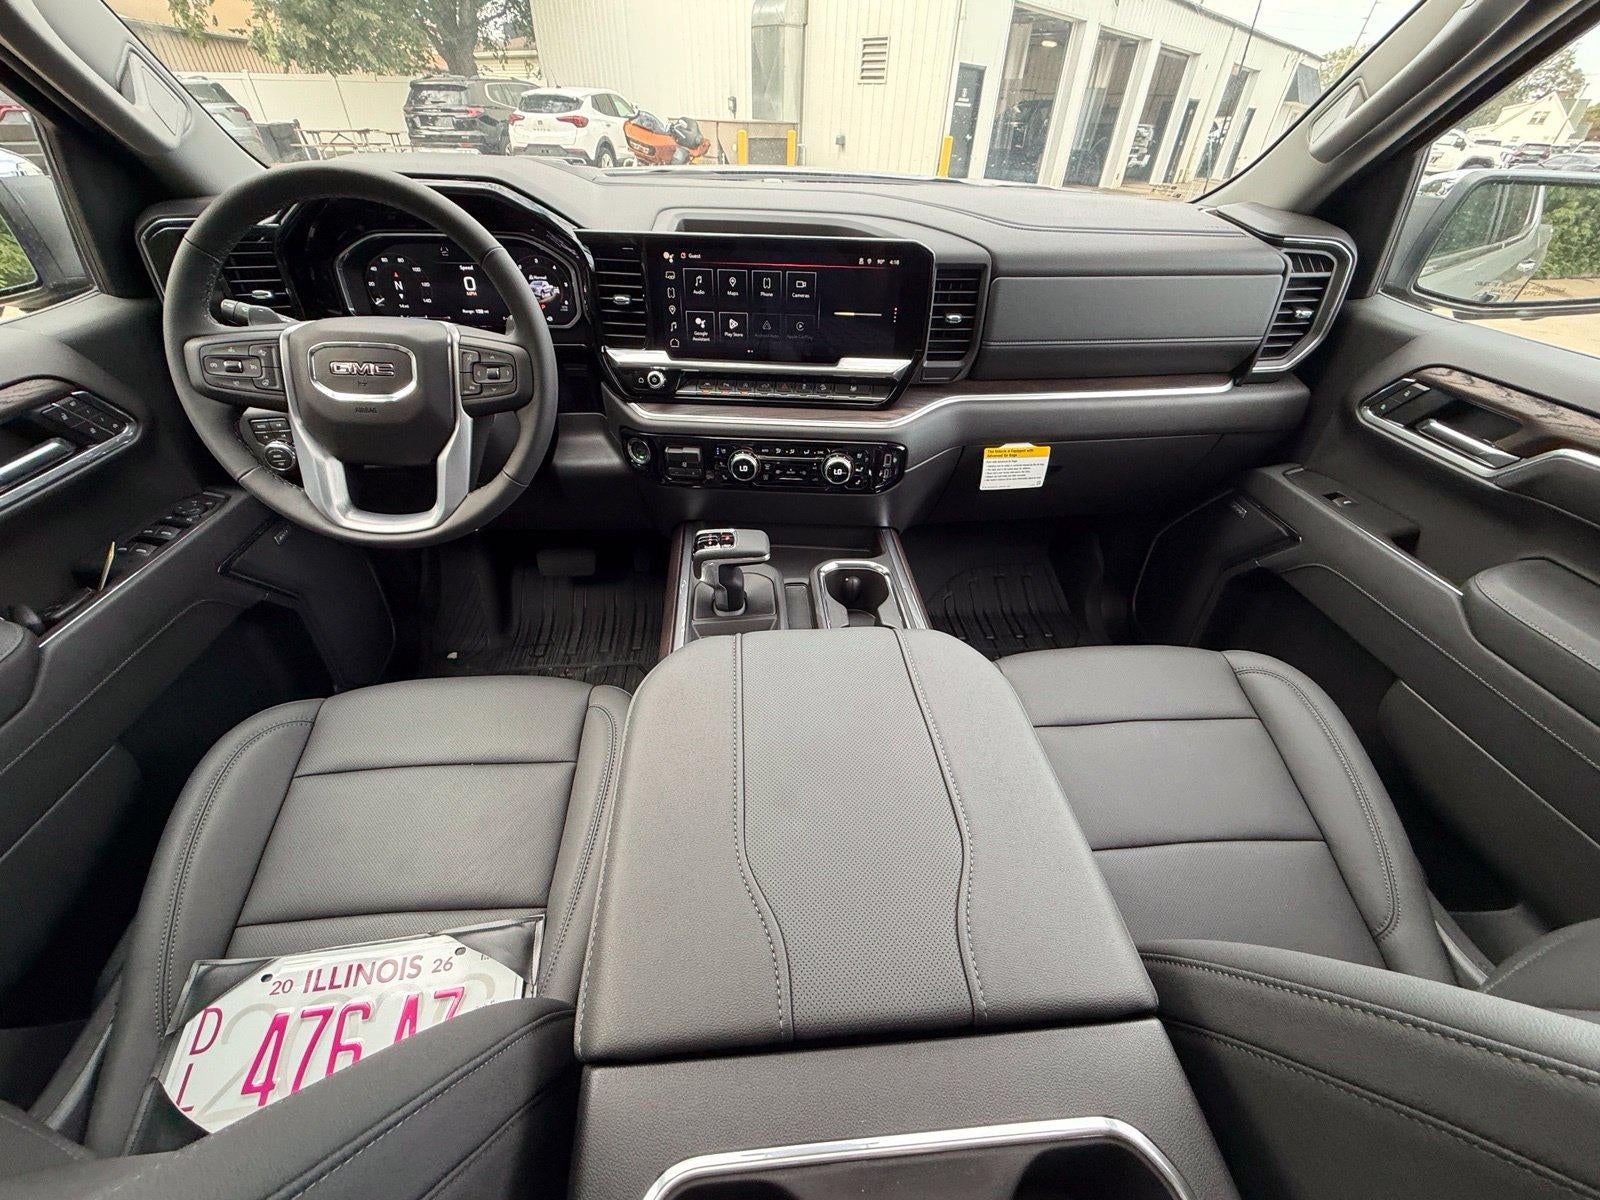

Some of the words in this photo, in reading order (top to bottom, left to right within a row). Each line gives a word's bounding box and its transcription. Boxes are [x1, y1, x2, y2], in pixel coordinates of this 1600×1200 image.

[394, 280, 403, 290] N
[463, 276, 477, 291] 0
[329, 361, 394, 376] GMC
[269, 979, 294, 996] 20
[303, 954, 424, 994] ILLINOIS
[431, 956, 454, 974] 26
